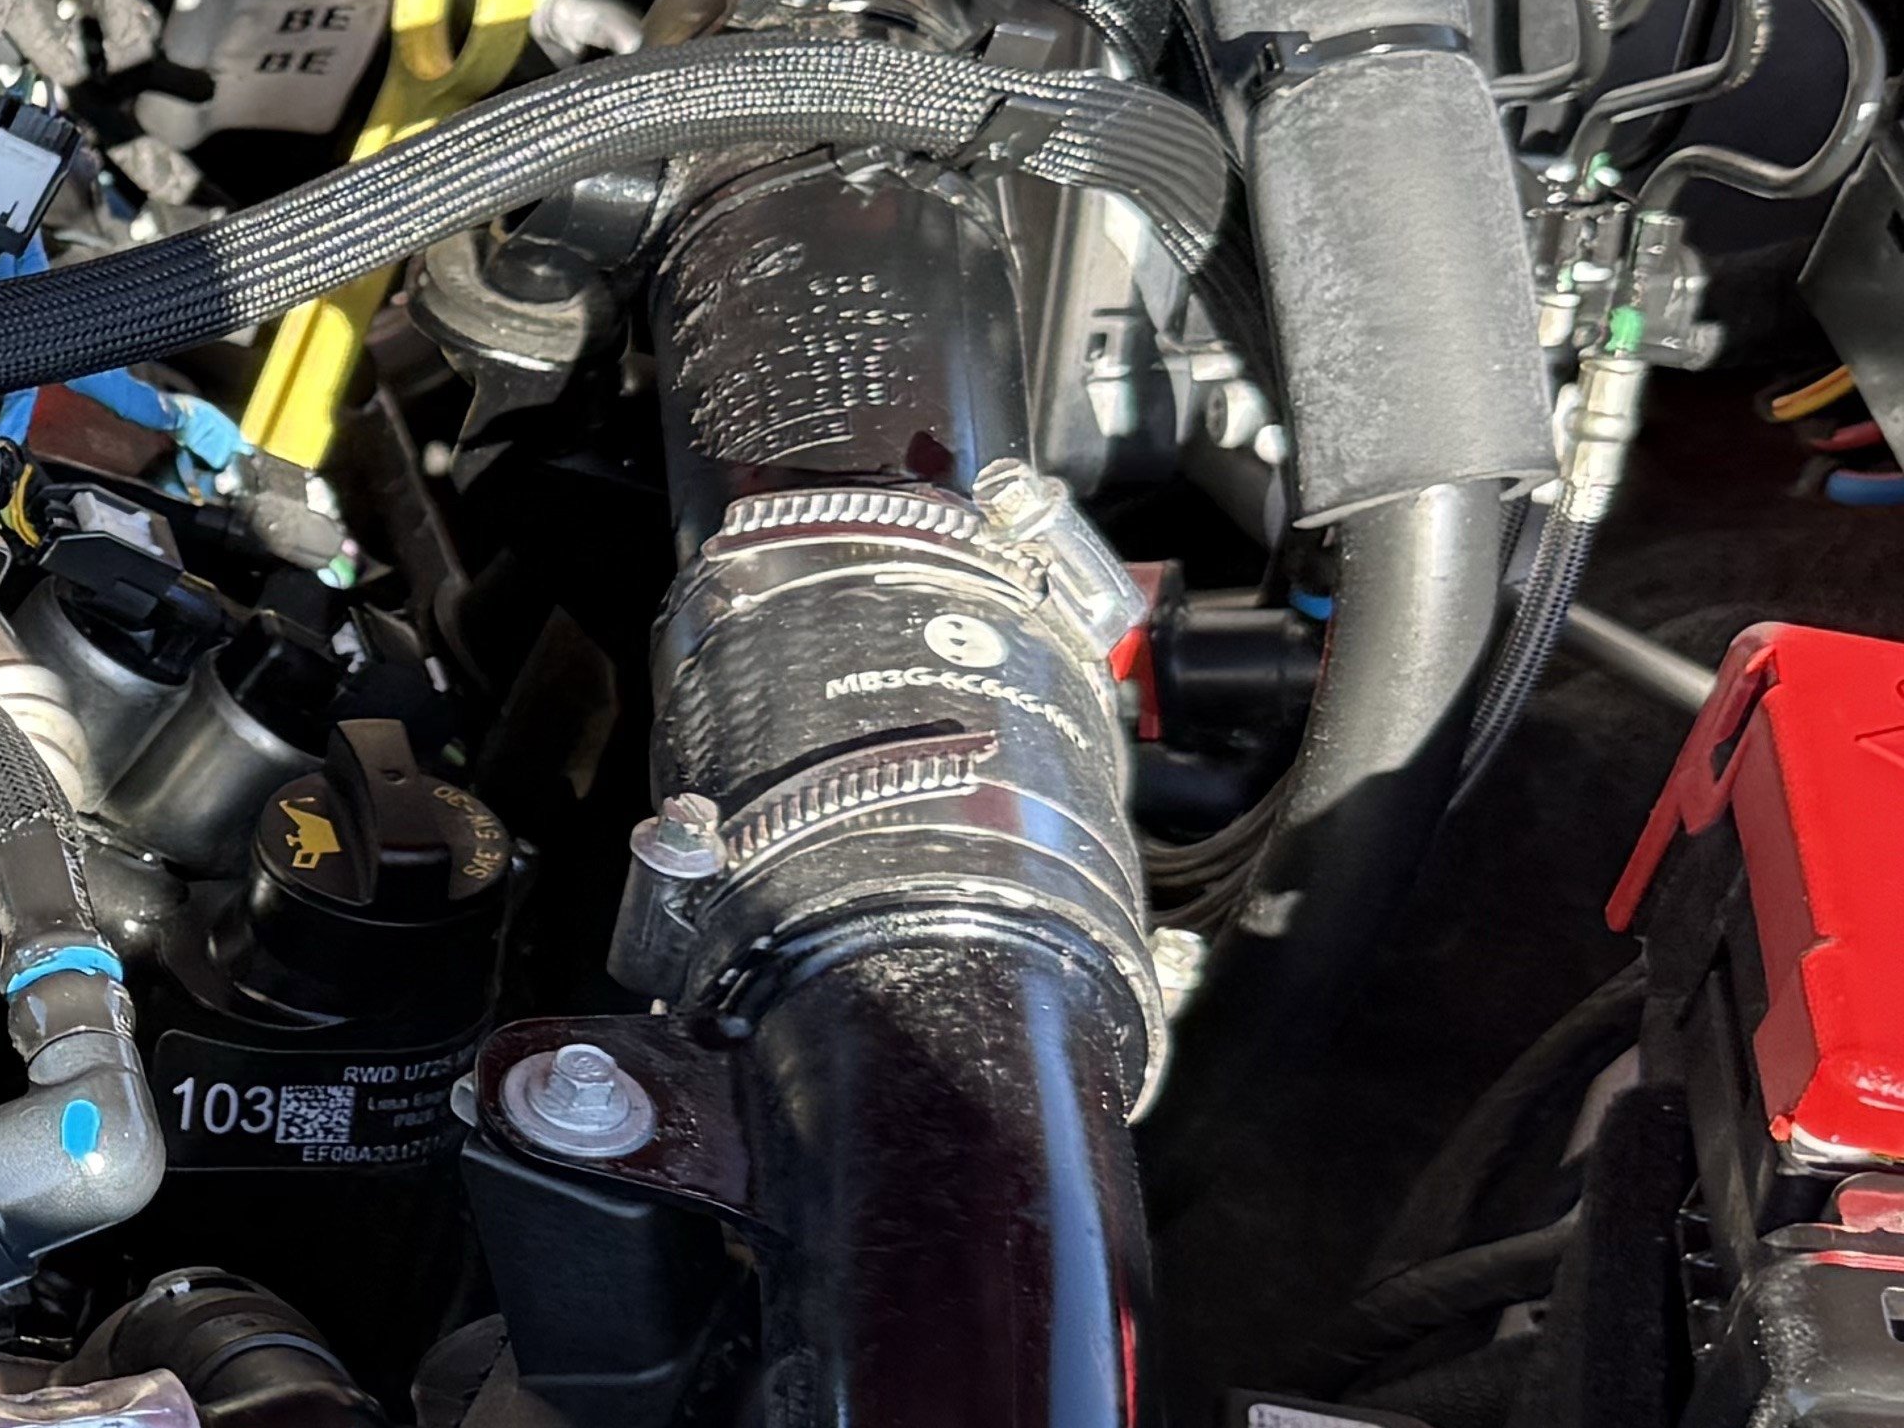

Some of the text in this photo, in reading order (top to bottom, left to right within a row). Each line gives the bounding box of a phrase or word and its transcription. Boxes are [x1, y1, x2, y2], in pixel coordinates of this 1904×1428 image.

[277, 4, 357, 34] BE
[254, 47, 337, 76] BE
[432, 785, 501, 880] SAE 5W-30
[342, 1064, 398, 1084] RWD
[171, 1076, 276, 1135] 103
